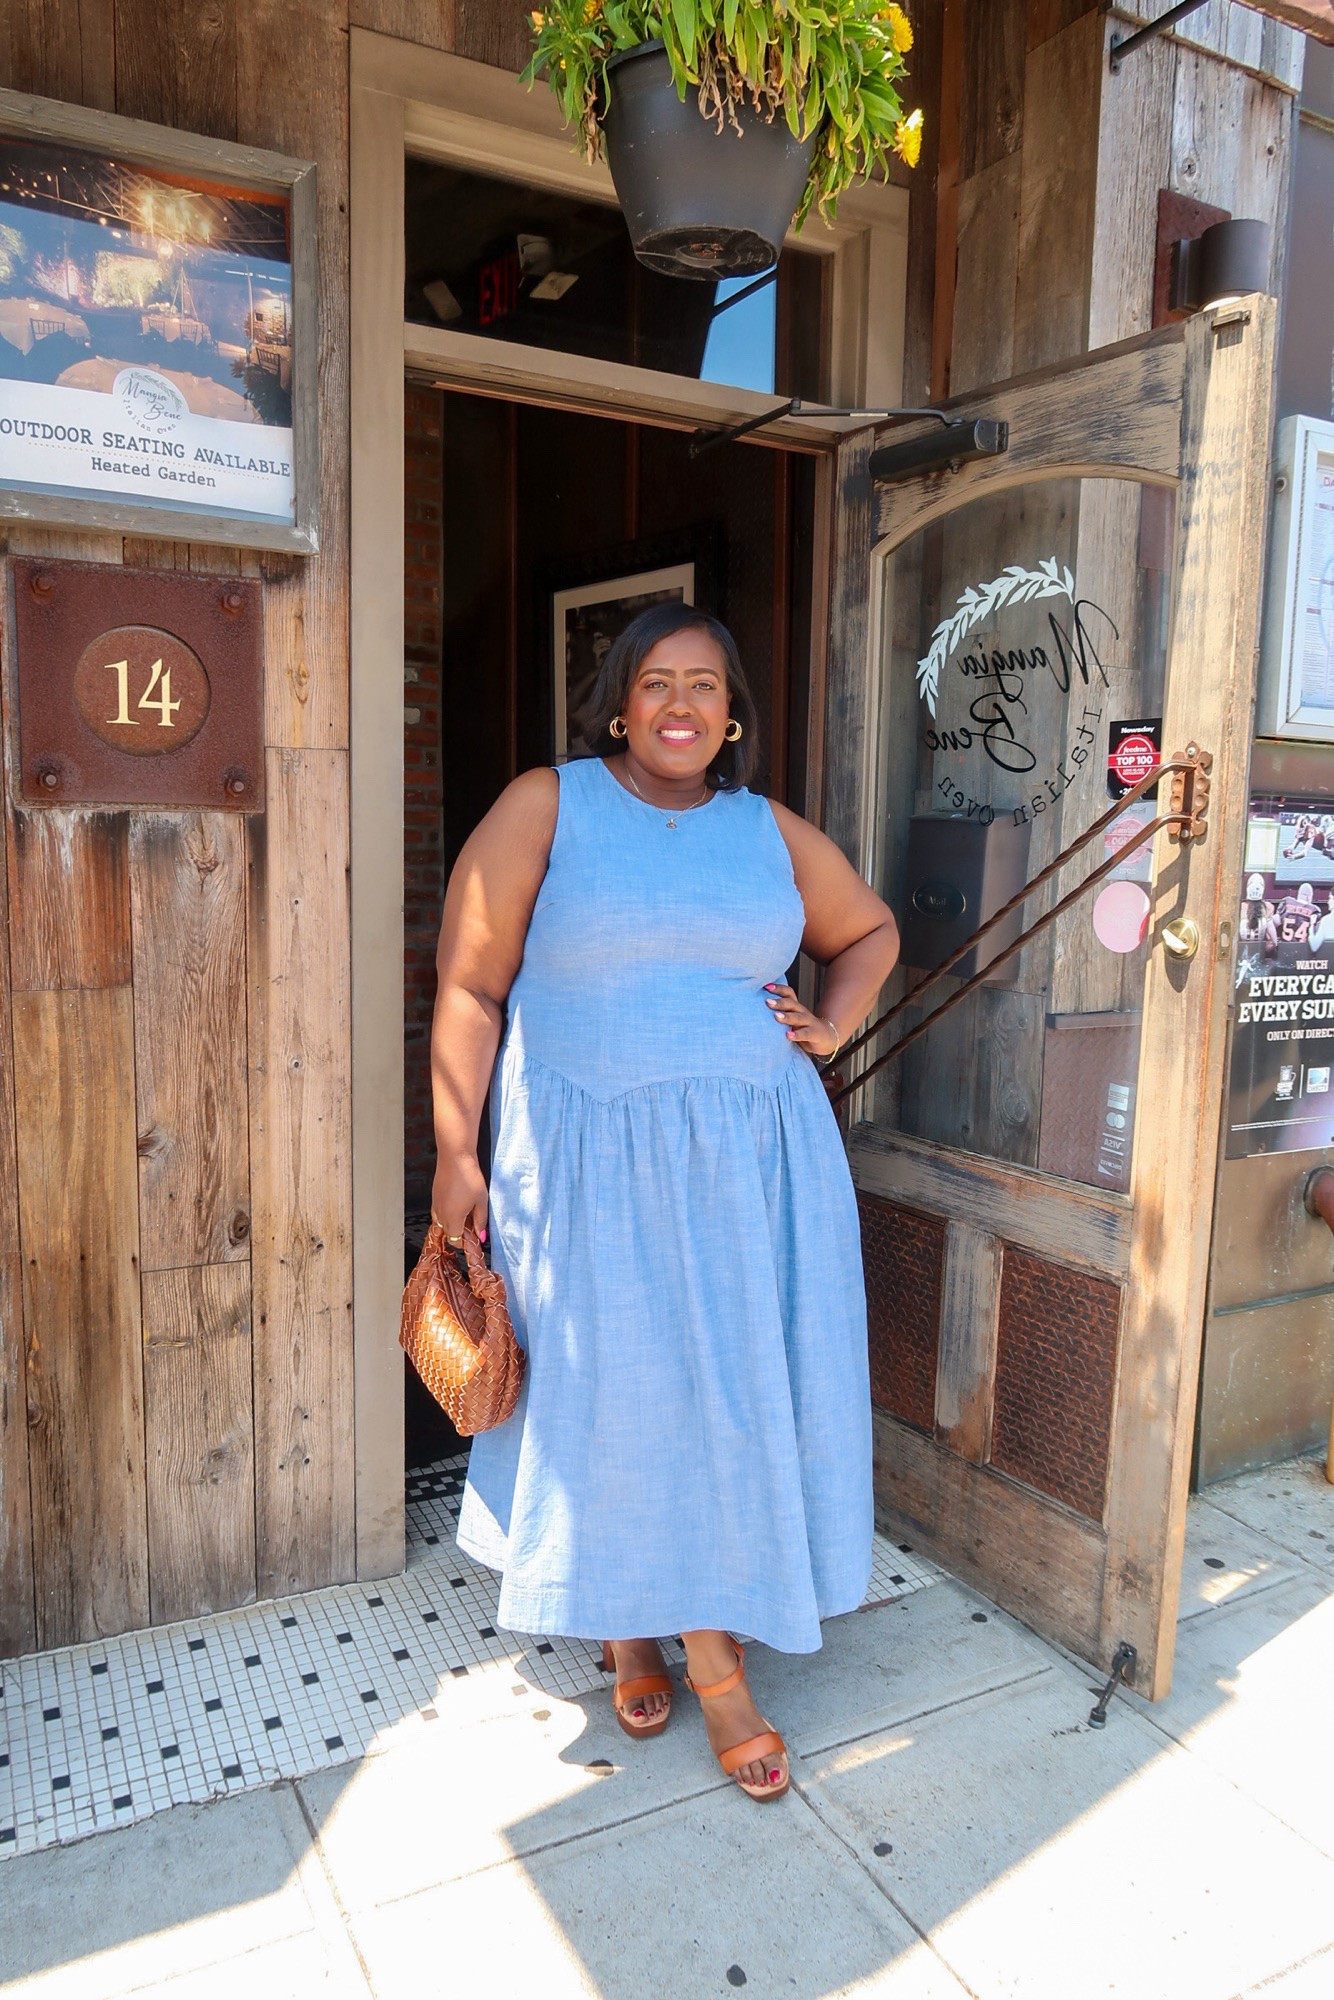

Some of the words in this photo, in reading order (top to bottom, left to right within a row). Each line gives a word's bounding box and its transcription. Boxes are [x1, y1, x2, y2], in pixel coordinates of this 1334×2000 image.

[143, 402, 182, 420] Bene
[0, 418, 94, 445] OUTDOOR
[103, 432, 185, 458] SEATING
[194, 447, 291, 477] AVAILABLE
[91, 457, 150, 477] Heated
[158, 467, 216, 487] Garden
[104, 658, 182, 727] 14
[1121, 725, 1155, 734] Newsday
[1116, 756, 1135, 766] TOP
[1136, 755, 1153, 765] 100
[1282, 917, 1310, 943] 54
[1296, 960, 1328, 970] WATCH
[1248, 975, 1313, 997] EVERY
[1238, 1000, 1302, 1023] EVERY
[1266, 1030, 1291, 1041] ONLY
[1291, 1029, 1304, 1039] ON
